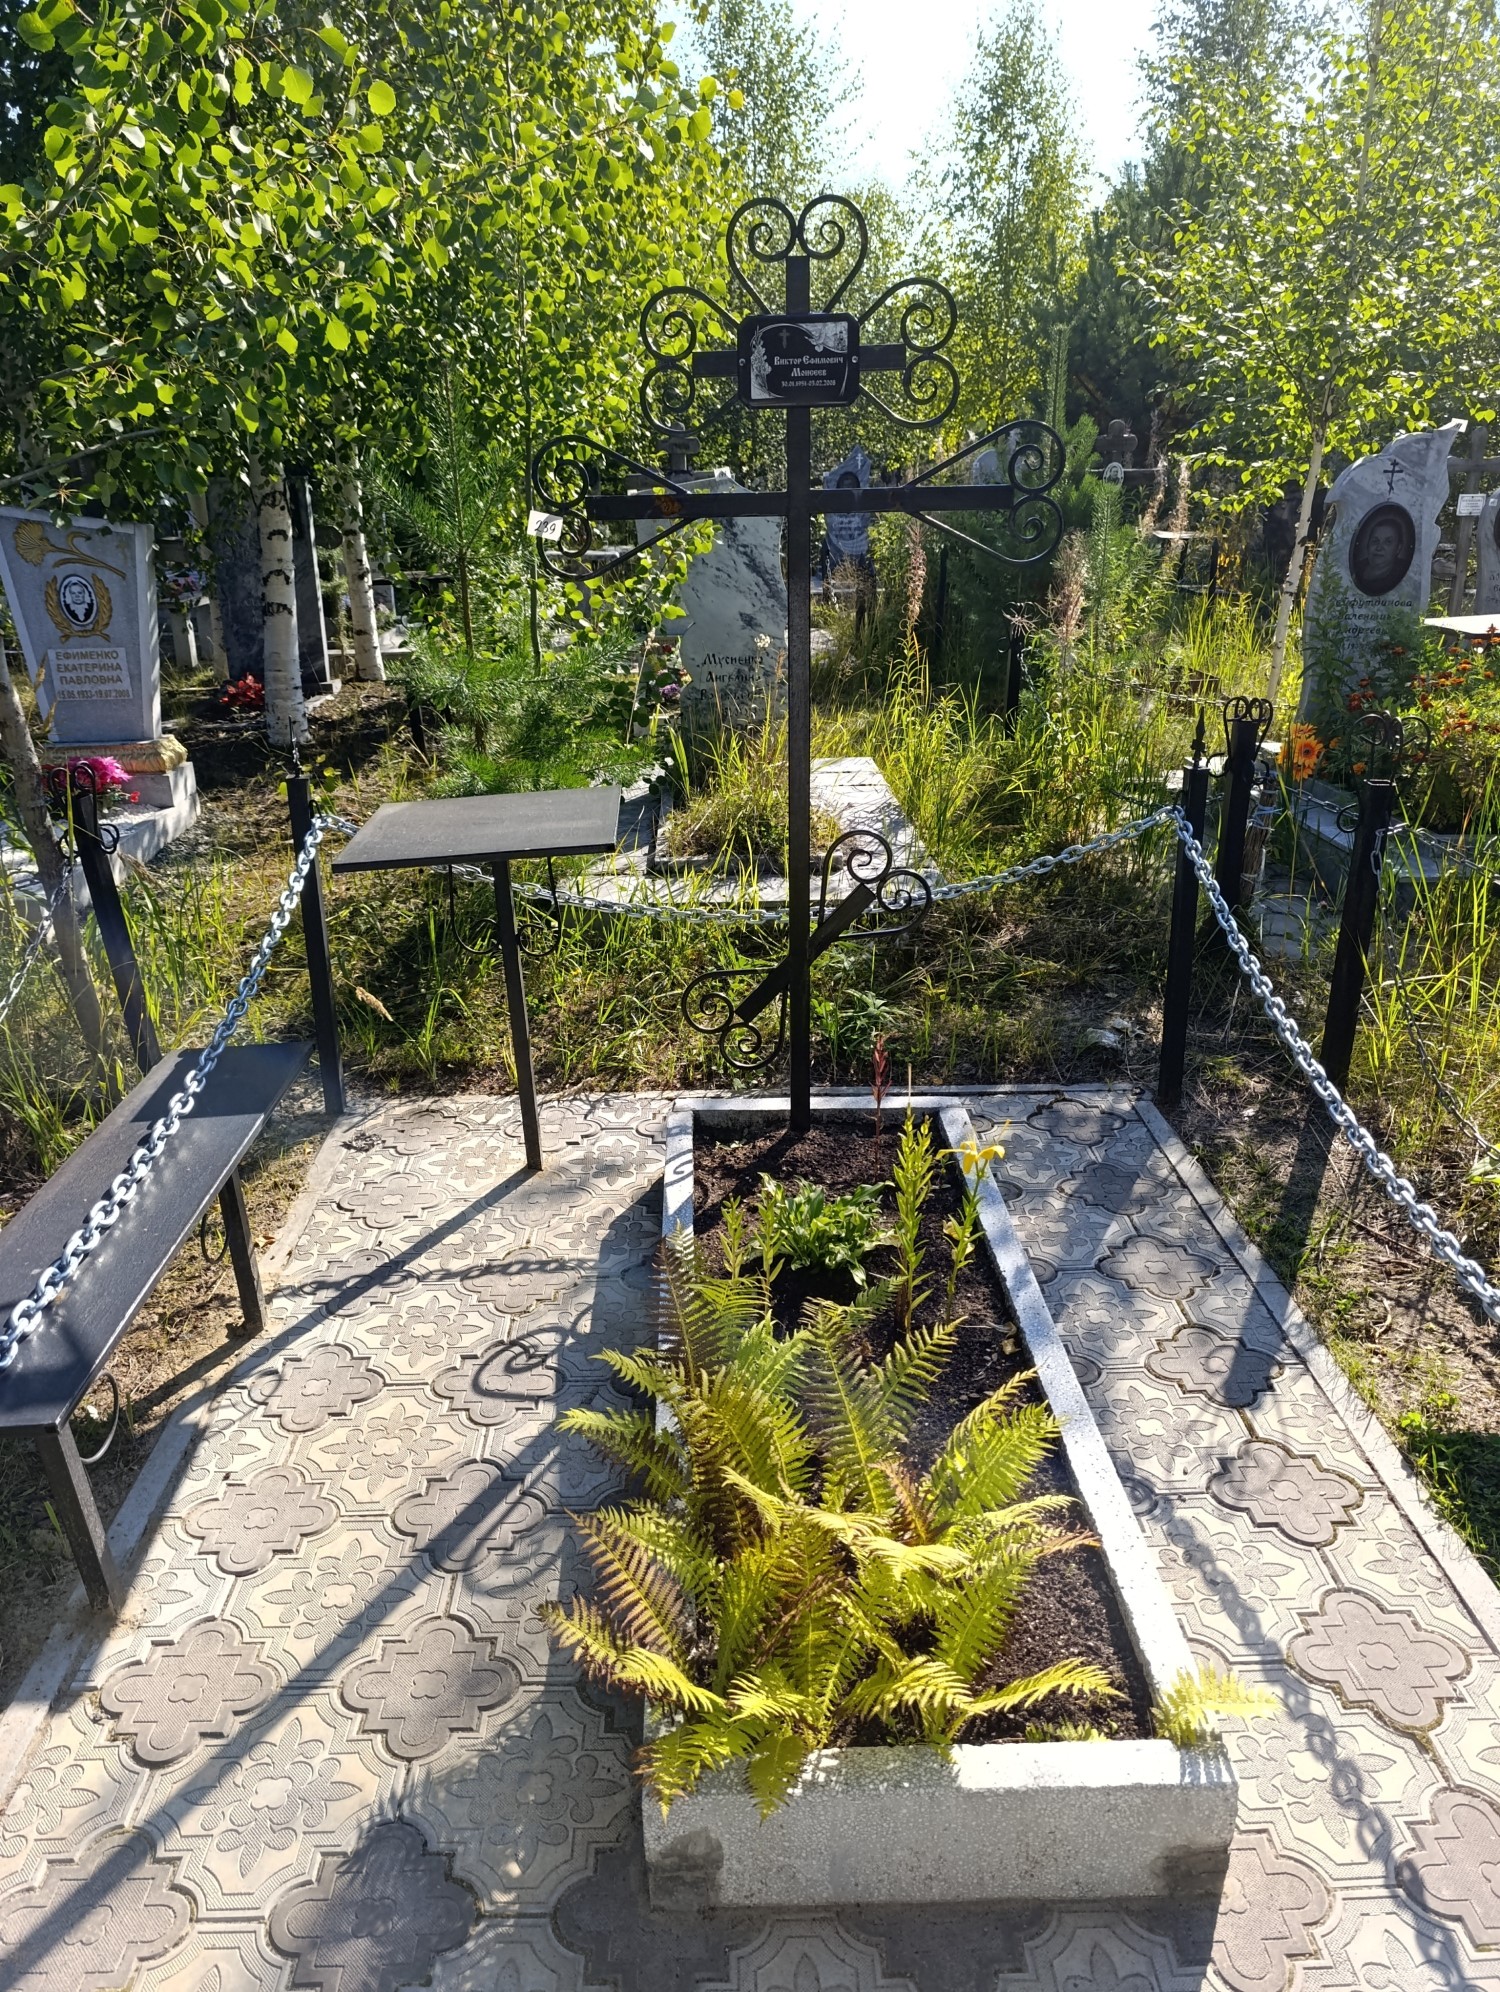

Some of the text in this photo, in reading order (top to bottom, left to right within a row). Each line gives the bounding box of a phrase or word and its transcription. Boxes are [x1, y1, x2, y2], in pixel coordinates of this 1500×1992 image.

[774, 355, 844, 366] Виктор Ефимович
[791, 367, 827, 377] Моисеев
[535, 519, 556, 535] 239
[55, 650, 119, 660] ЕФИМЕНКО
[57, 662, 123, 673] ЕКАТЕРИНА
[59, 674, 123, 685] ПАВЛОВНА
